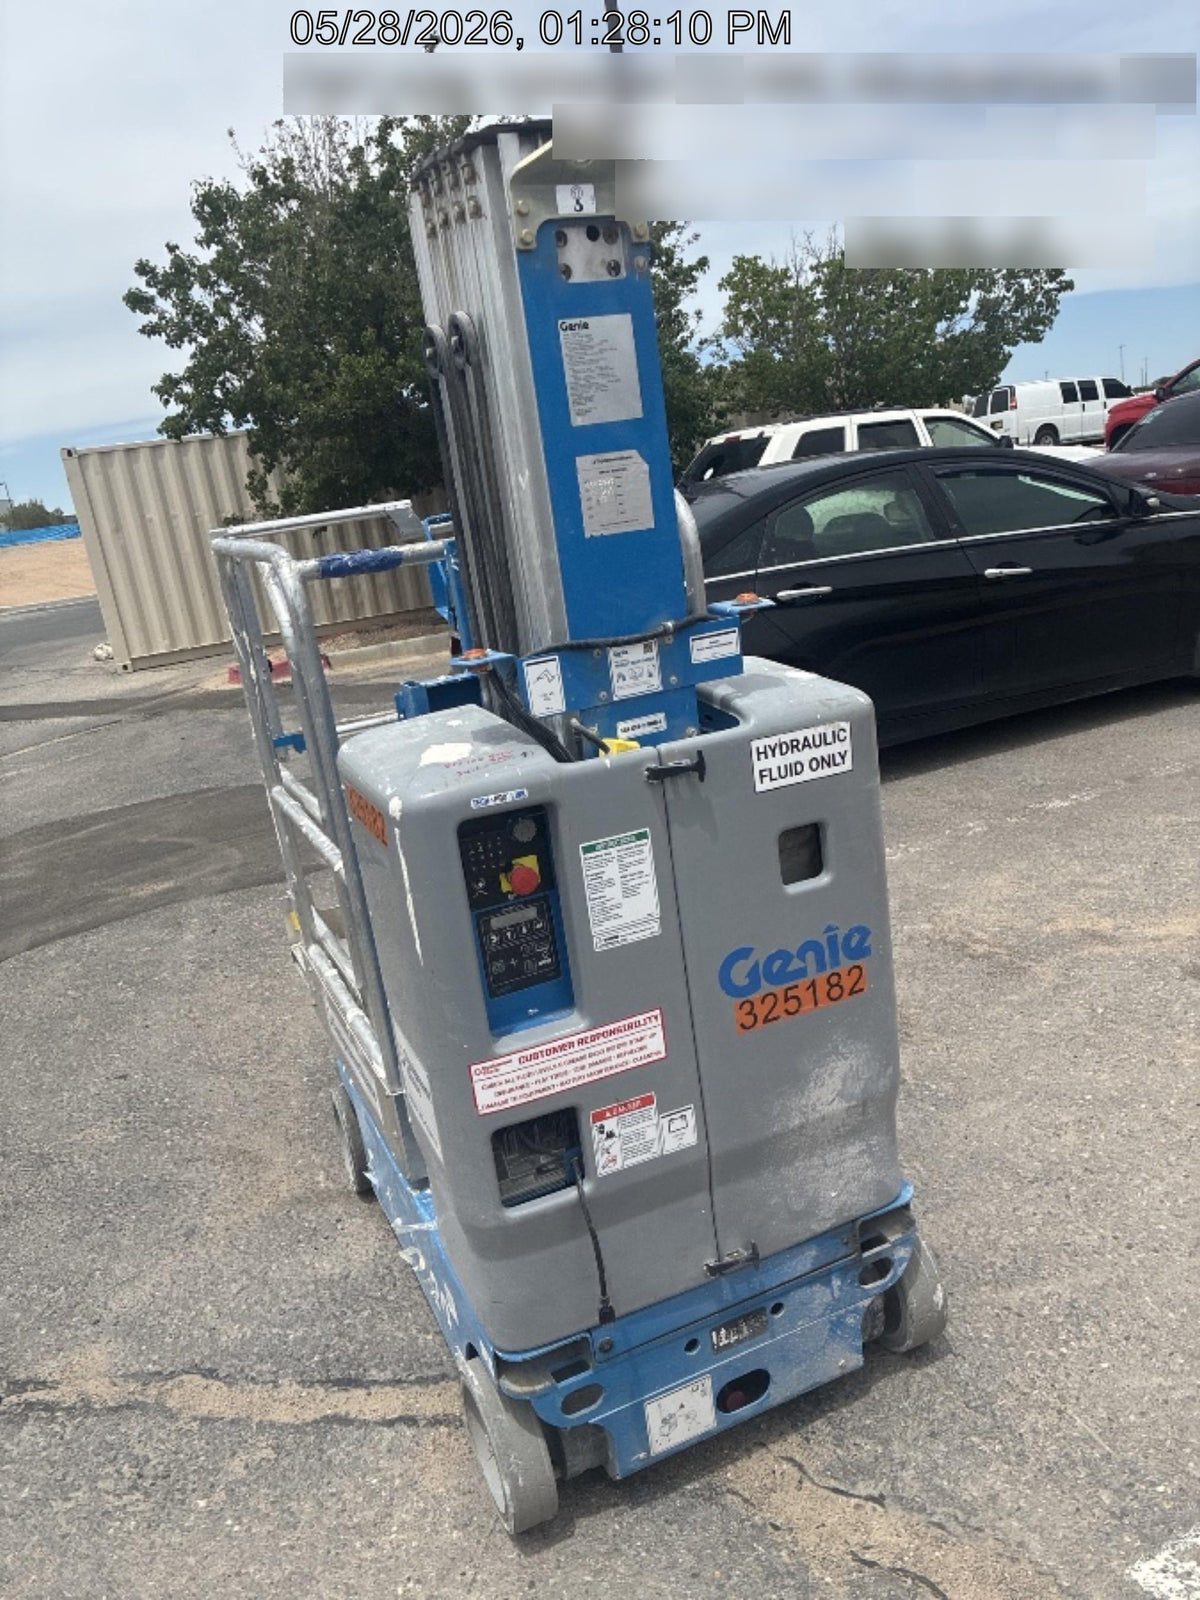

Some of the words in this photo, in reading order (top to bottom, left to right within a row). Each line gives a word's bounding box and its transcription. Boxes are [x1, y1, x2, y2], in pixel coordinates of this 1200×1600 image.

[560, 320, 590, 331] Genie
[756, 728, 847, 761] HYDRAULIC
[758, 761, 804, 784] FLUID
[808, 750, 847, 772] ONLY
[718, 924, 872, 998] Genie
[738, 965, 864, 1030] 325182
[518, 1041, 574, 1065] CUSTOMER
[576, 1015, 659, 1047] RESPONSIBILITY
